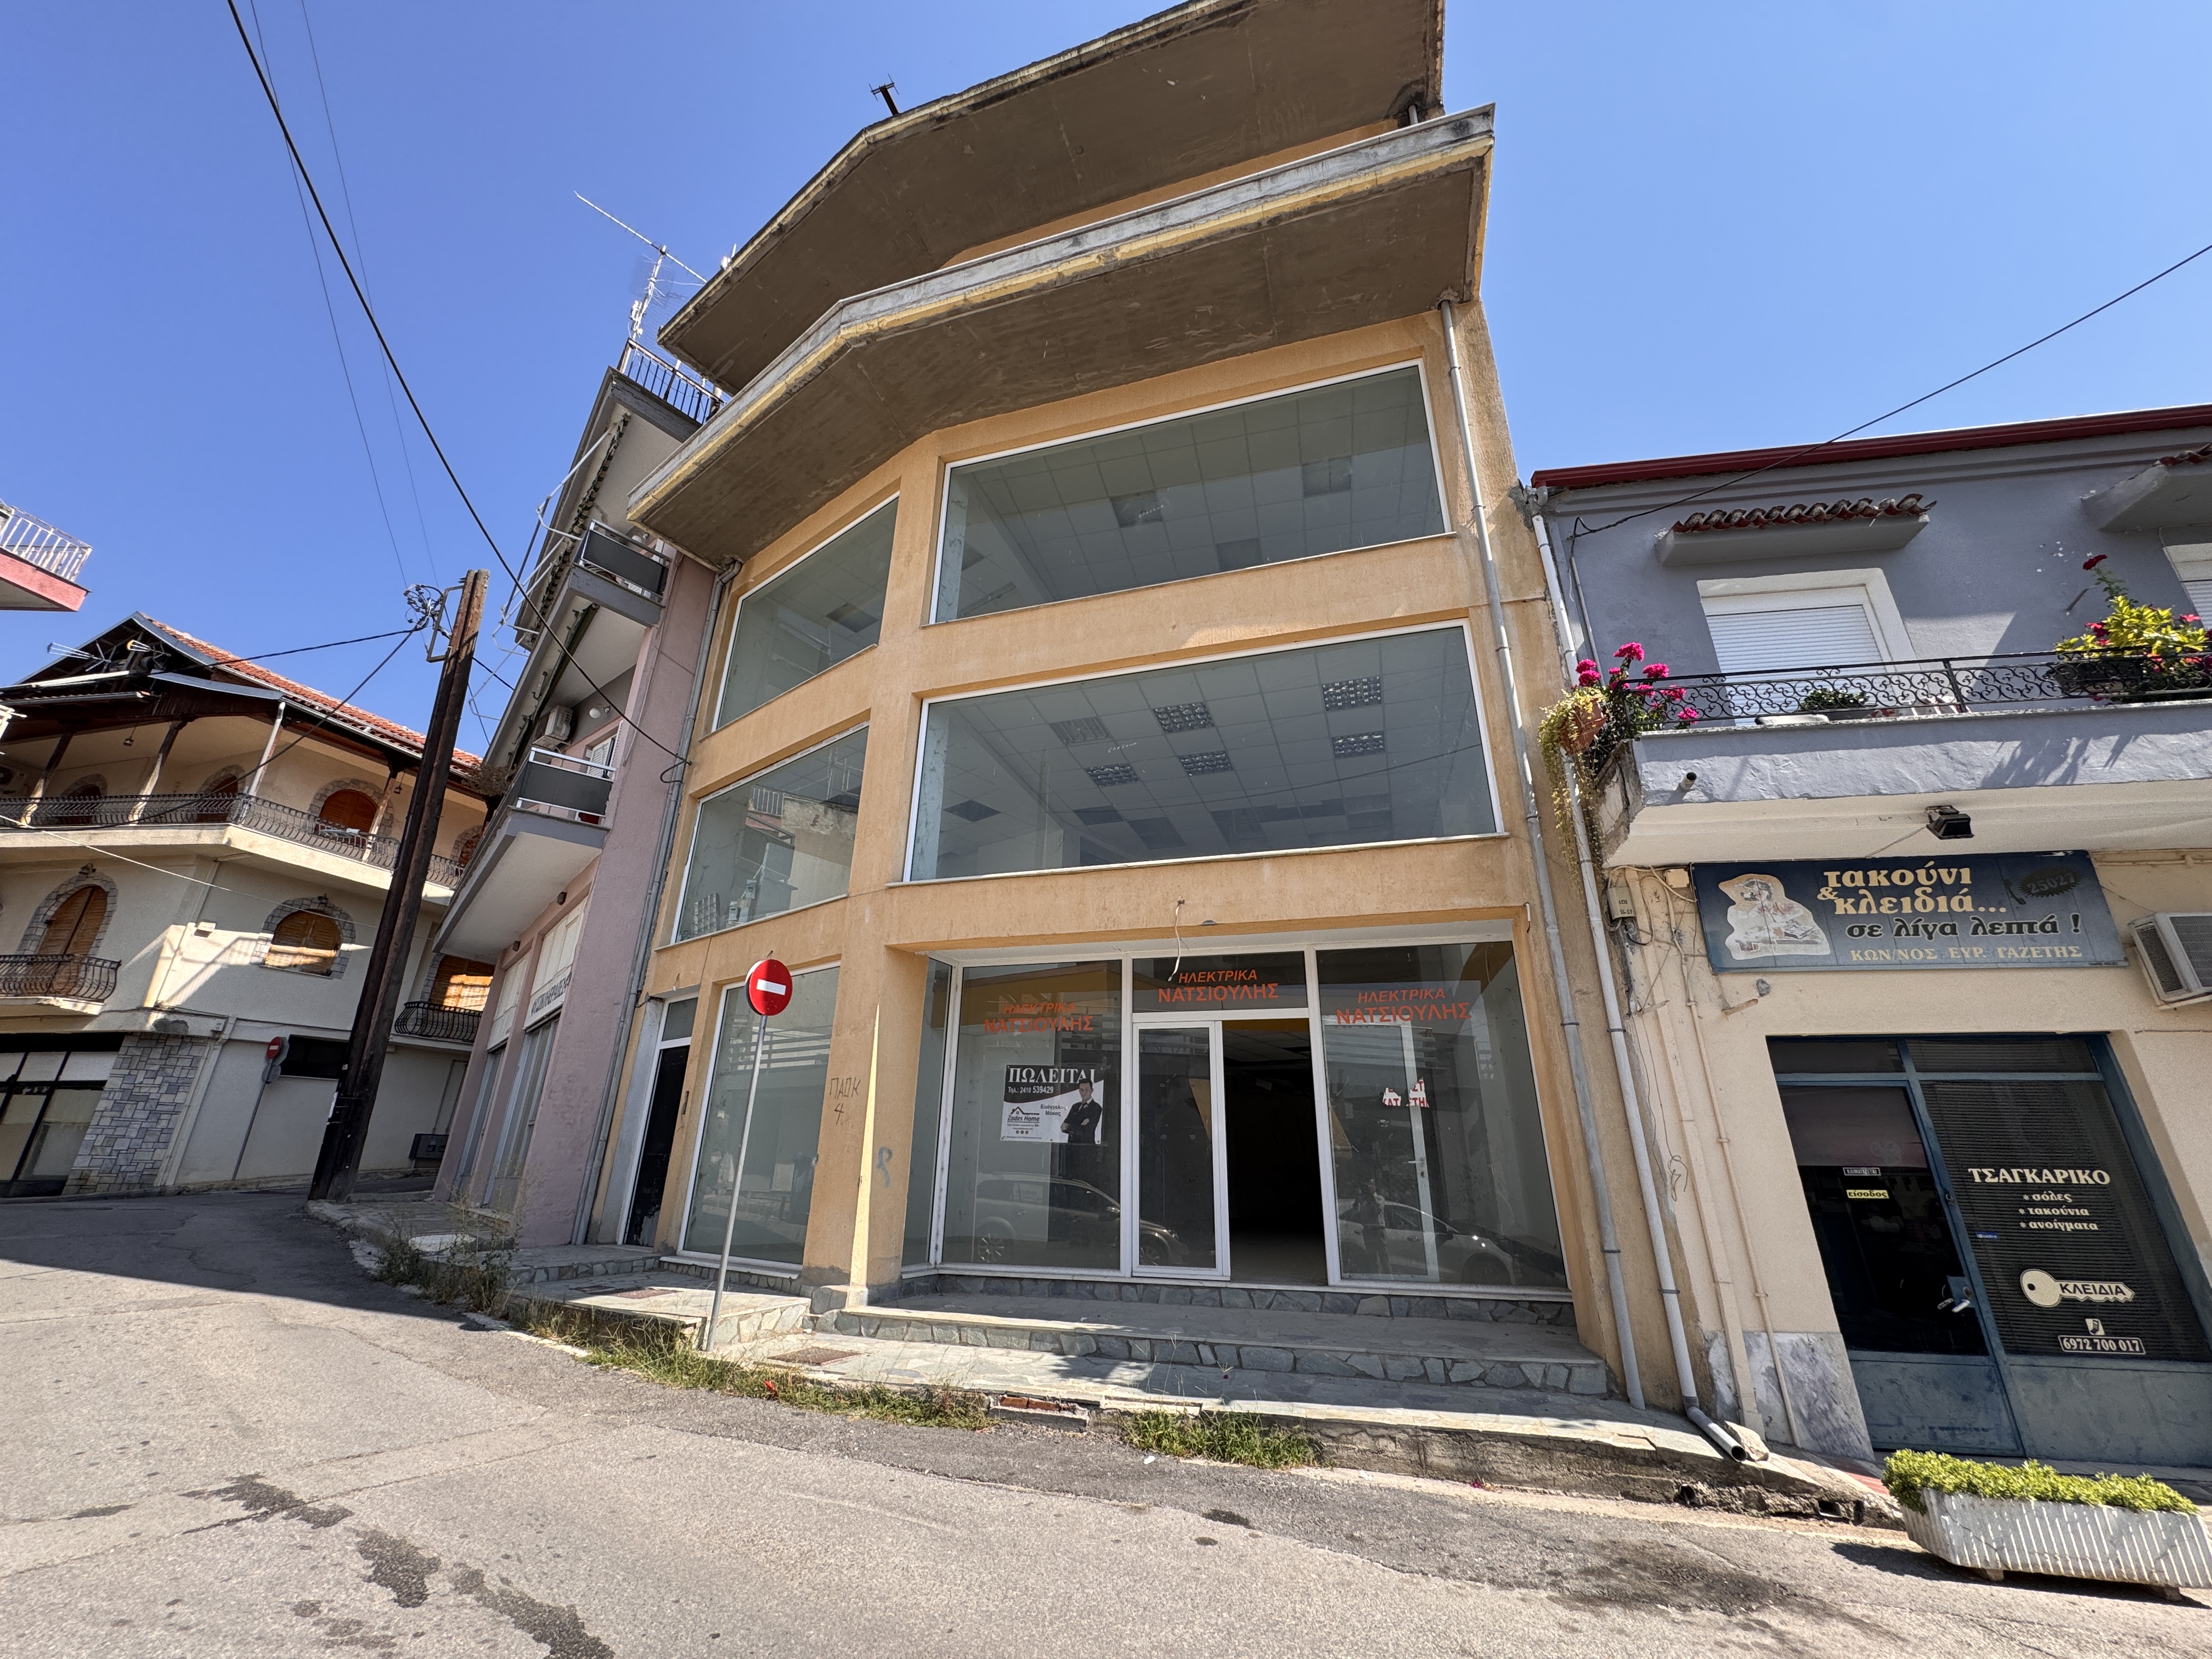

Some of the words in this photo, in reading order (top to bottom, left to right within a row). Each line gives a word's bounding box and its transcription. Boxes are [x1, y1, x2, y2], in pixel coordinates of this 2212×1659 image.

[1823, 860, 1972, 888] τακούνι
[1816, 887, 1838, 900] &
[1846, 923, 1883, 938] σε
[1893, 917, 1960, 941] λίγα
[1970, 913, 2060, 936] λεπτά
[1948, 946, 1988, 959] ΕΥΡ.
[1997, 945, 2083, 959] ΓΑΖΕΤΗΣ
[1178, 968, 1258, 984] ΗΛΕΚΤΡΙΚΑ
[1158, 983, 1280, 1003] ΝΑΤΣΙΟΥΛΗΣ
[1357, 987, 1446, 1003] ΗΛΕΚΤΡΙΚΑ
[1003, 1002, 1076, 1014] ΗΛΕΚΤΡΙΚΑ
[1336, 1002, 1472, 1024] ΝΑΤΣΙΟΥΛΗΣ
[984, 1015, 1094, 1033] ΝΑΤΣΙΟΥΛΗΣ
[1008, 1068, 1096, 1084] ΠΩΛΕΙΤΑΙ
[830, 1077, 861, 1099] ΠΑΟΚ
[834, 1103, 844, 1125] 4
[1968, 1167, 2111, 1185] ΤΣΑΓΚΑΡΙΚΟ
[1847, 1189, 1887, 1199] είσοδος
[2032, 1190, 2073, 1203] σόλες
[2027, 1205, 2090, 1216] τακούνια
[2028, 1218, 2100, 1232] ανοίγματα
[2059, 1283, 2128, 1296] ΚΛΕΙΔΙΑ
[2063, 1338, 2092, 1350] 6972
[2093, 1339, 2117, 1351] 700
[2118, 1339, 2140, 1352] 017
